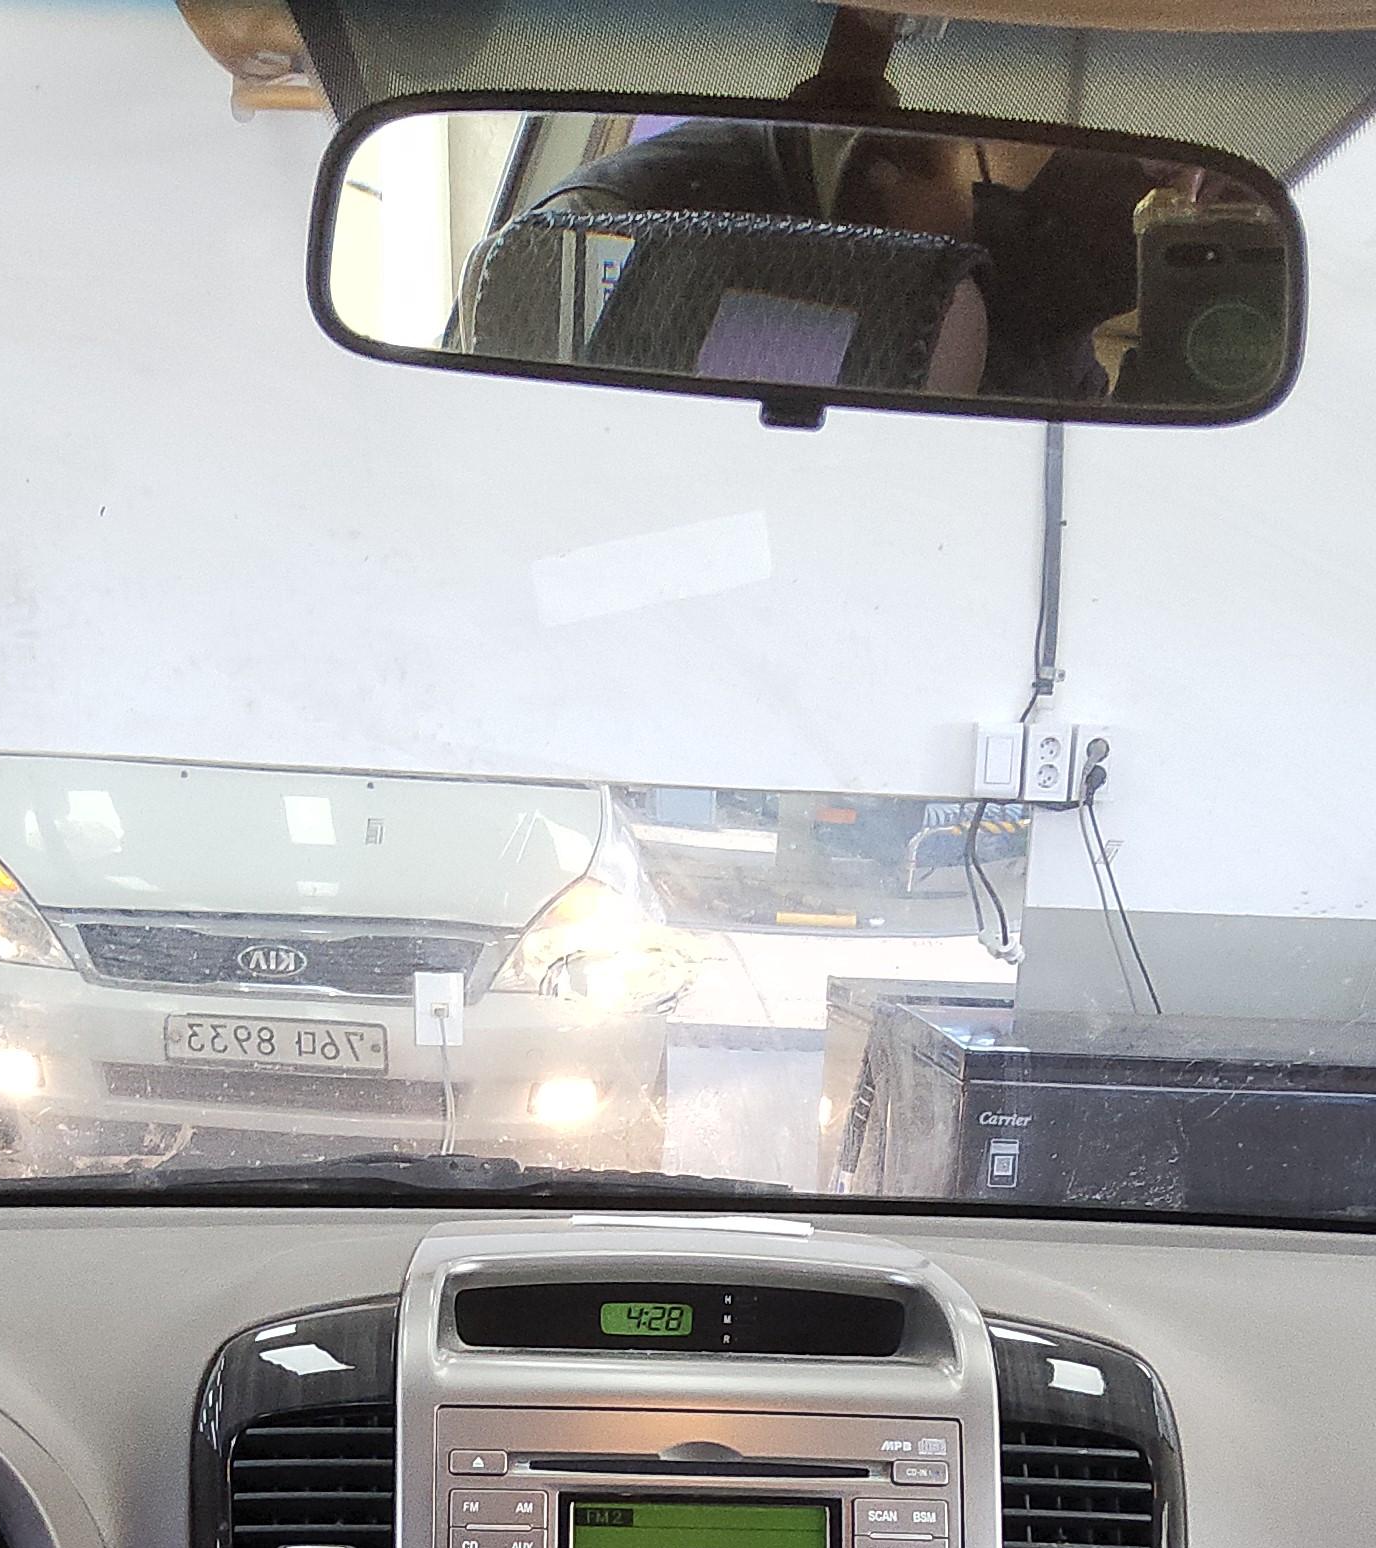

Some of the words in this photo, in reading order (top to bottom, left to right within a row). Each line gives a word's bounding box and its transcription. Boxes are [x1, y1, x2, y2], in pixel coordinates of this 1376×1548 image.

[978, 1111, 1032, 1126] Carrier
[626, 1305, 684, 1332] 4:28
[462, 1501, 479, 1513] FM
[515, 1502, 534, 1513] AM
[867, 1510, 898, 1522] SCAN
[912, 1511, 936, 1523] BSM
